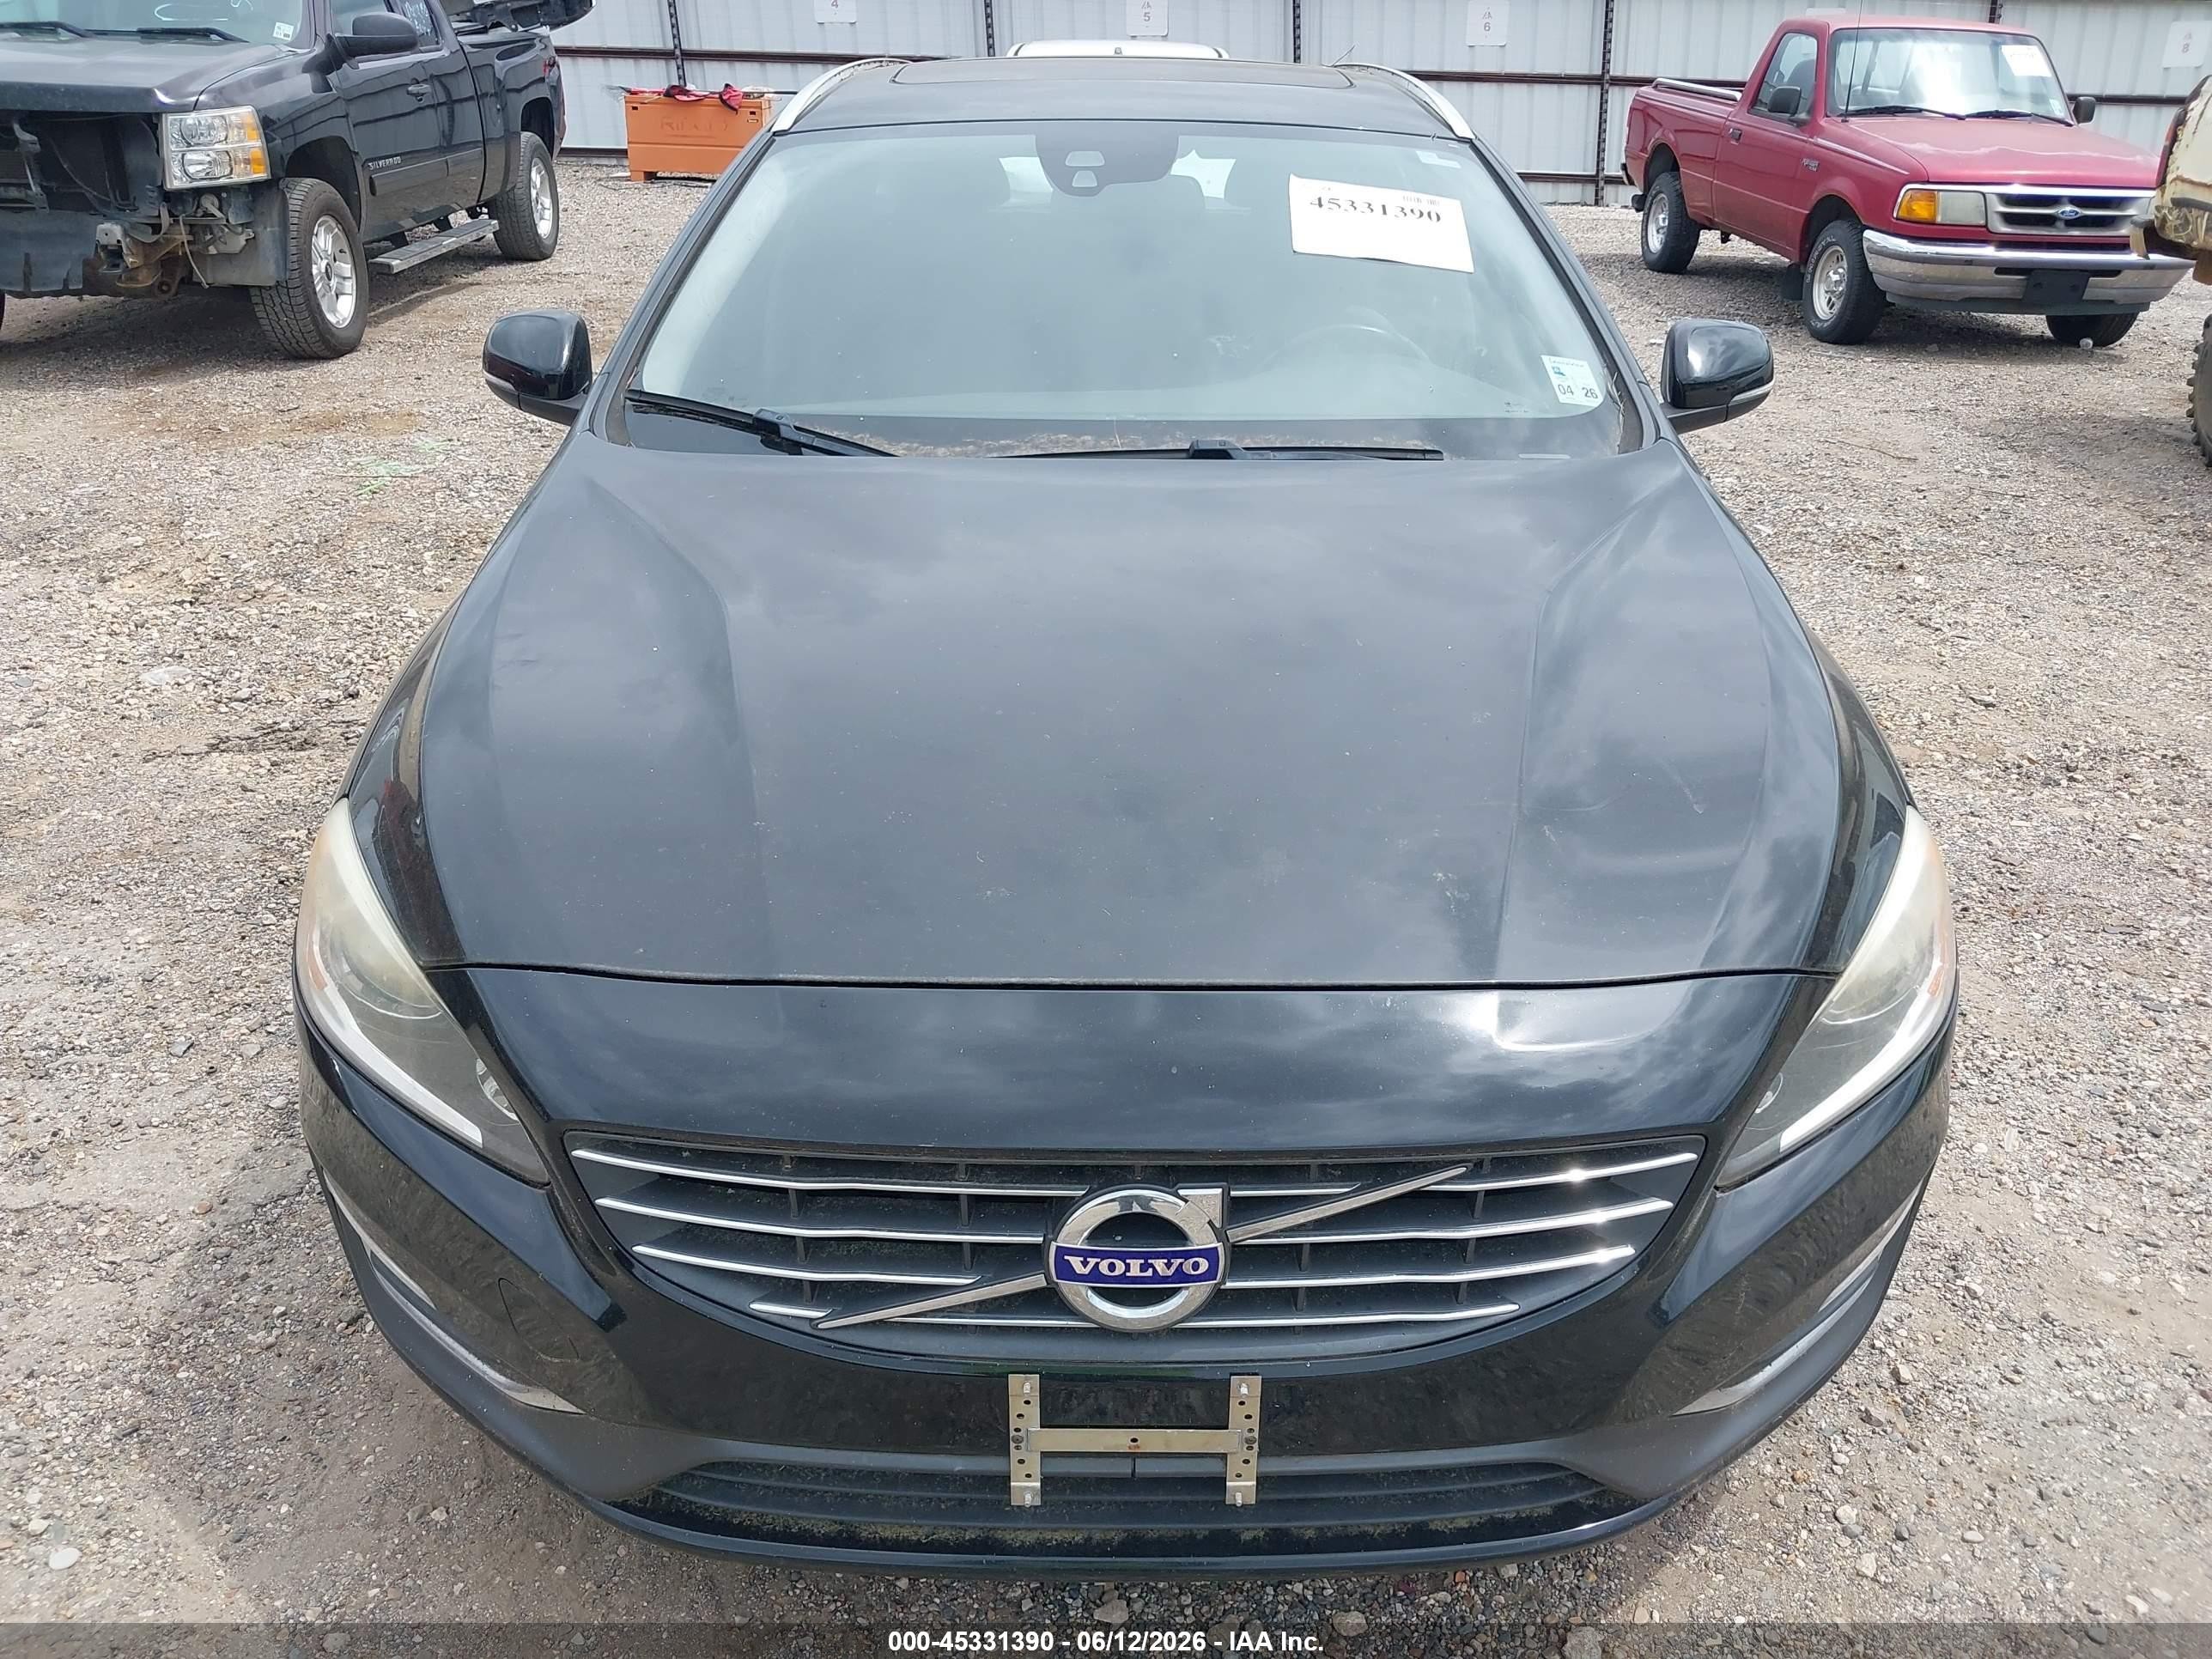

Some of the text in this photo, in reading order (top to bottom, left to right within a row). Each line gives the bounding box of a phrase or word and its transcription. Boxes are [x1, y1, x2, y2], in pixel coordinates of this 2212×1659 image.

[831, 0, 838, 9] 4
[1144, 12, 1151, 21] 5
[1484, 21, 1491, 31] 6
[368, 156, 401, 170] SILVERADO
[1310, 196, 1441, 222] 45331390
[1558, 384, 1598, 399] 04 26
[1064, 1255, 1209, 1277] VOLVO
